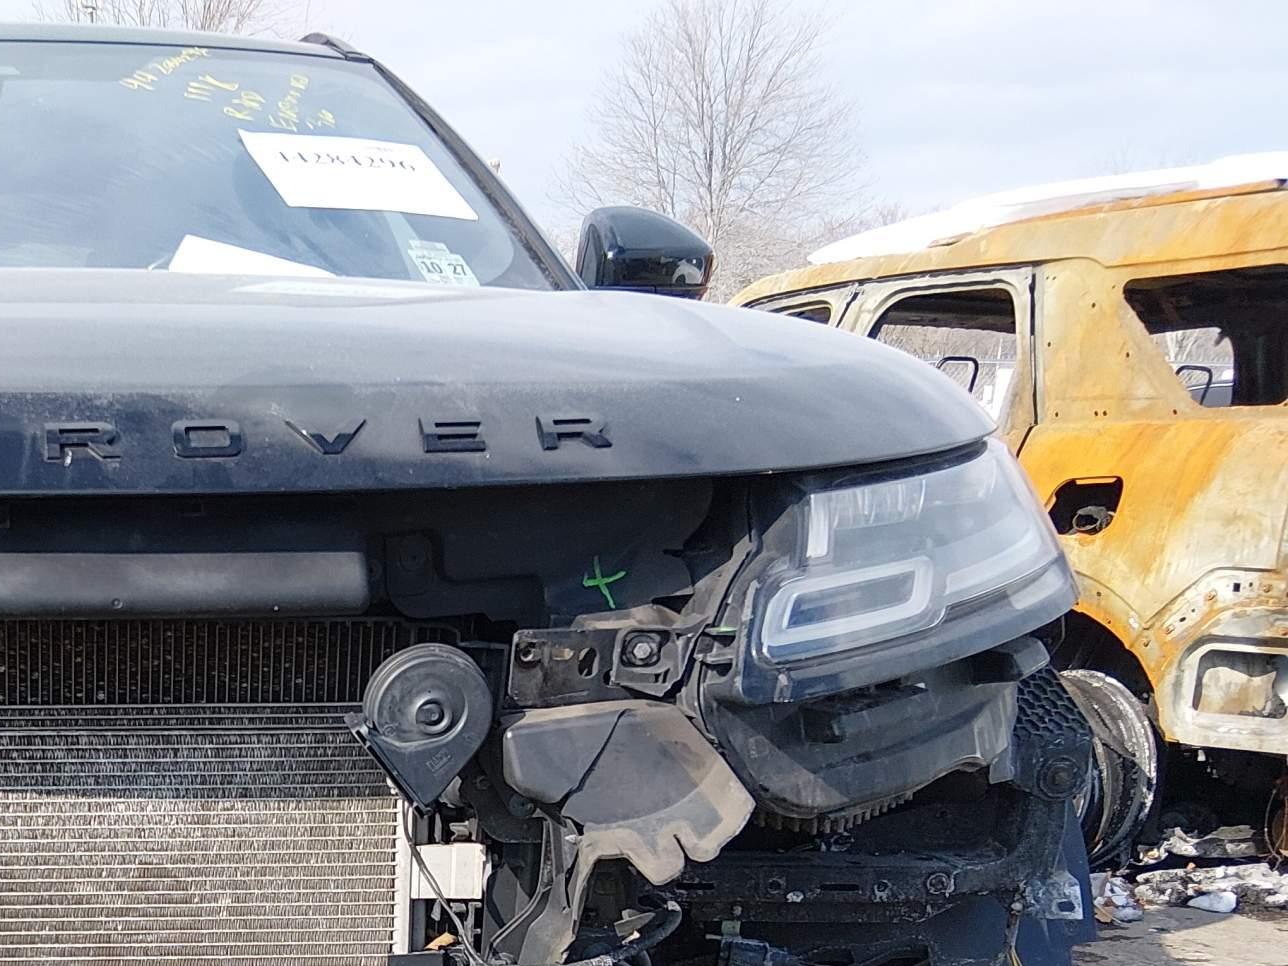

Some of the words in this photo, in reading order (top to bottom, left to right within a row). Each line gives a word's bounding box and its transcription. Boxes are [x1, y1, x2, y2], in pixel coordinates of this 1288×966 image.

[419, 261, 444, 274] 10
[447, 263, 467, 276] 27
[44, 414, 613, 463] ROVER
